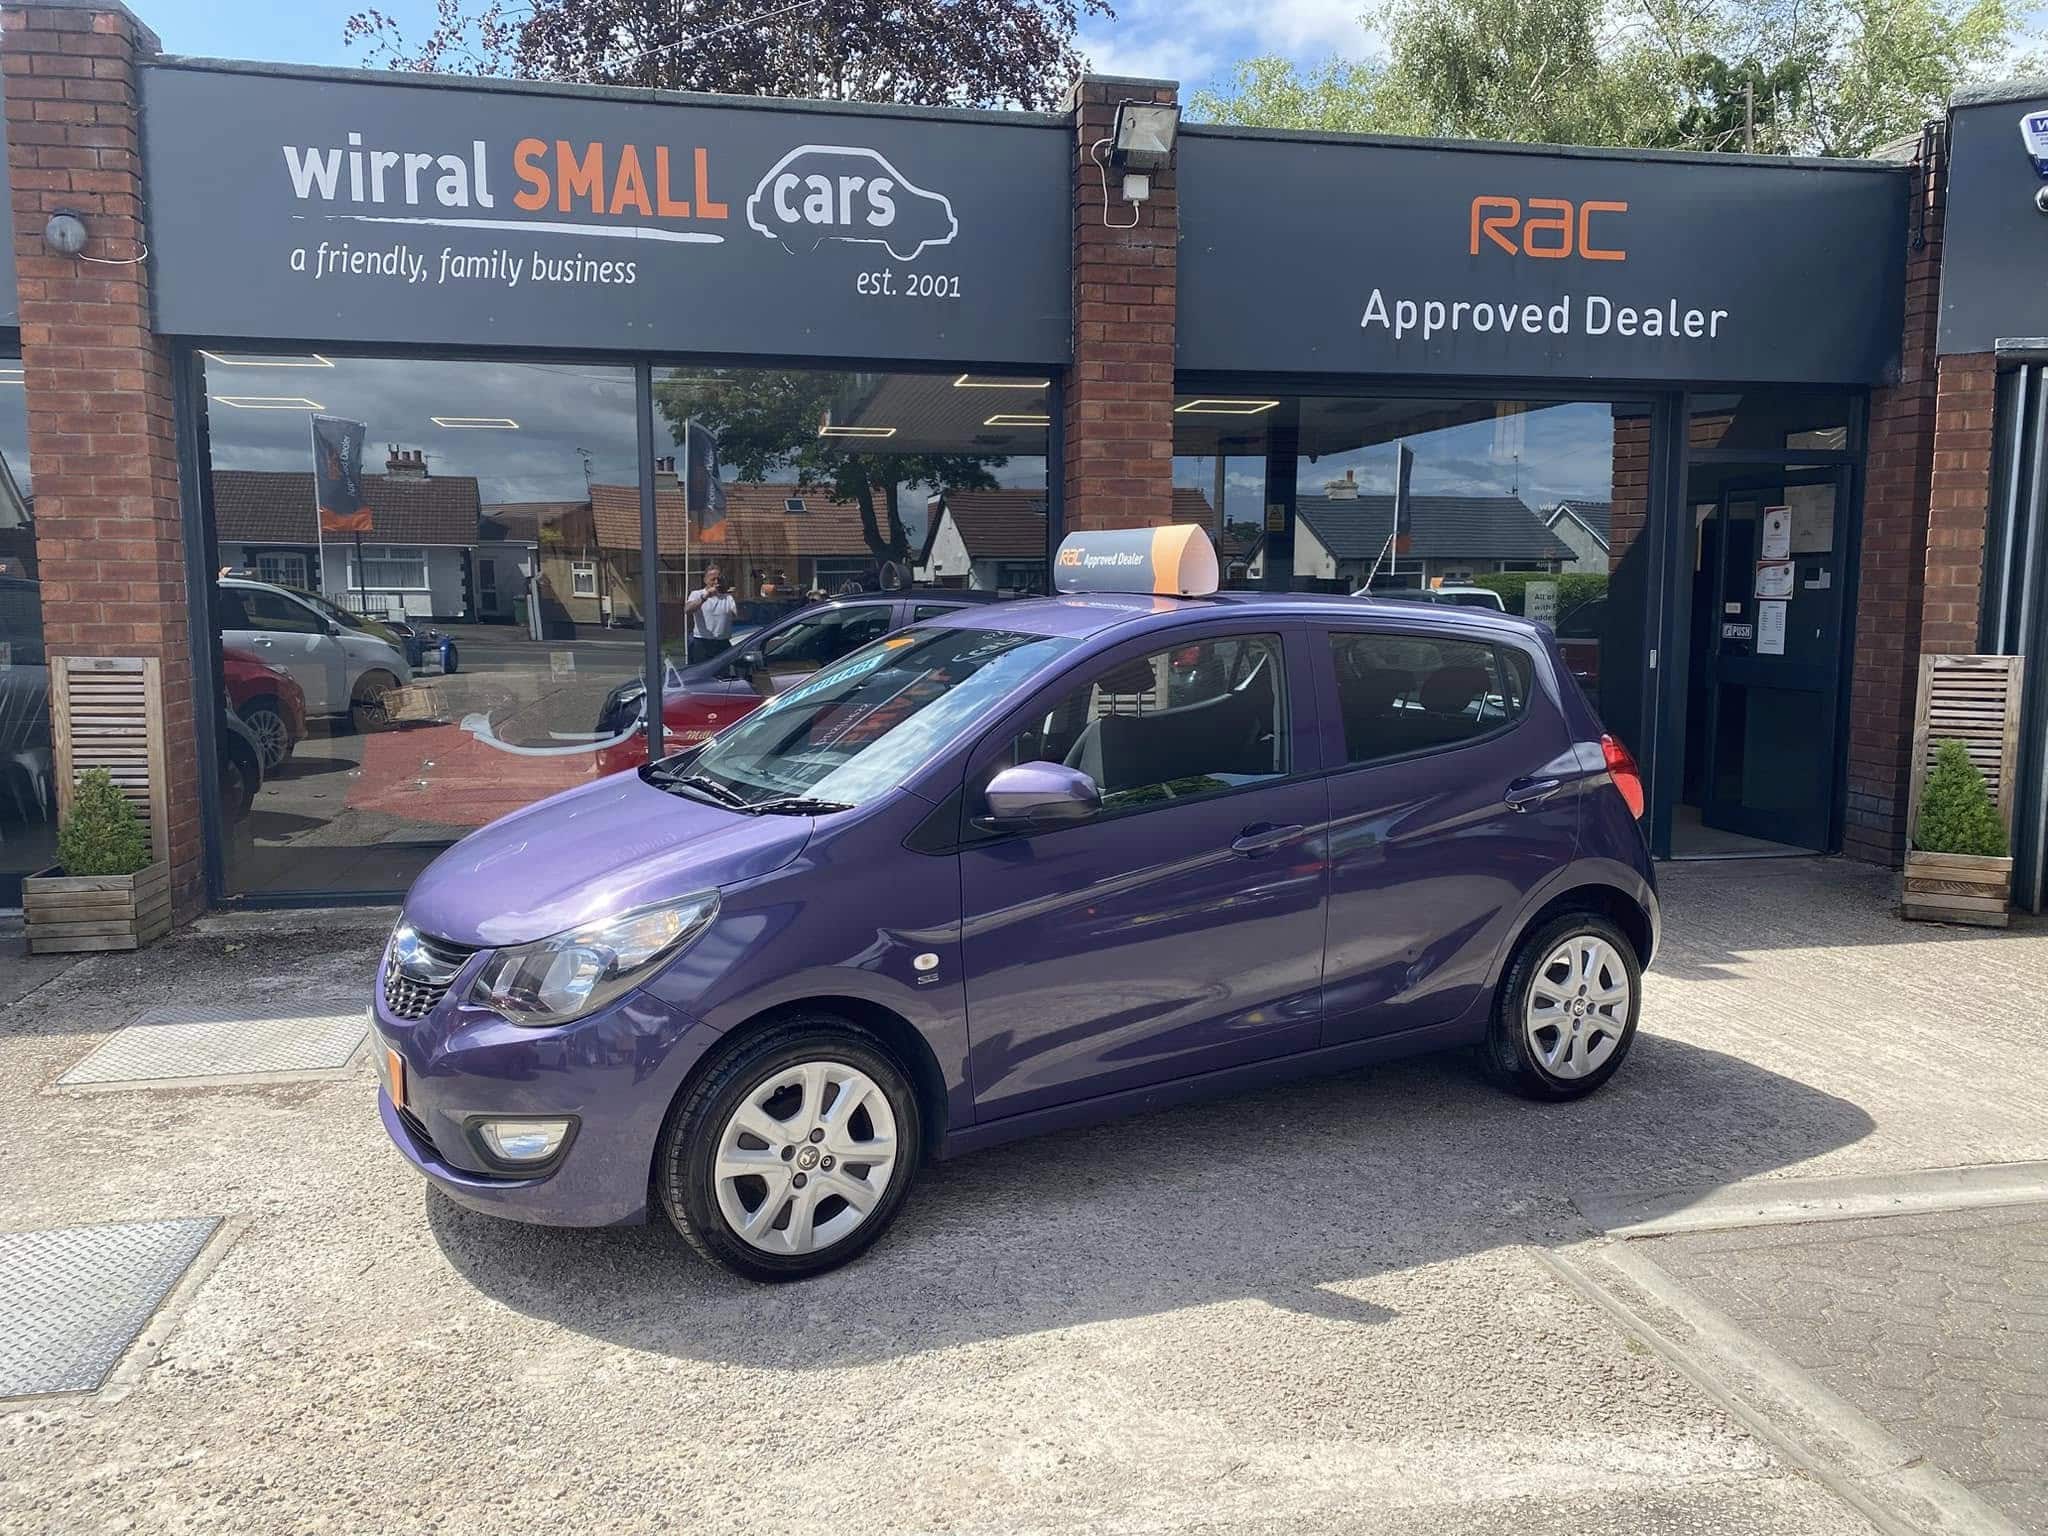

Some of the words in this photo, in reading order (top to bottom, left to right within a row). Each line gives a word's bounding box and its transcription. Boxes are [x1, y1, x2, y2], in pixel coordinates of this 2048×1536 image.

[283, 131, 494, 209] wirral
[512, 138, 728, 219] SMALL
[773, 173, 896, 227] cars
[290, 247, 306, 272] a
[315, 242, 428, 284] friendly,
[438, 247, 523, 287] family
[531, 251, 637, 284] business
[857, 267, 897, 296] est.
[905, 274, 961, 298] 2001
[1360, 288, 1569, 340] Approved
[1586, 296, 1729, 338] Dealer
[1083, 552, 1117, 569] Approved
[1117, 551, 1144, 566] Dealer
[1732, 625, 1750, 637] PUSH
